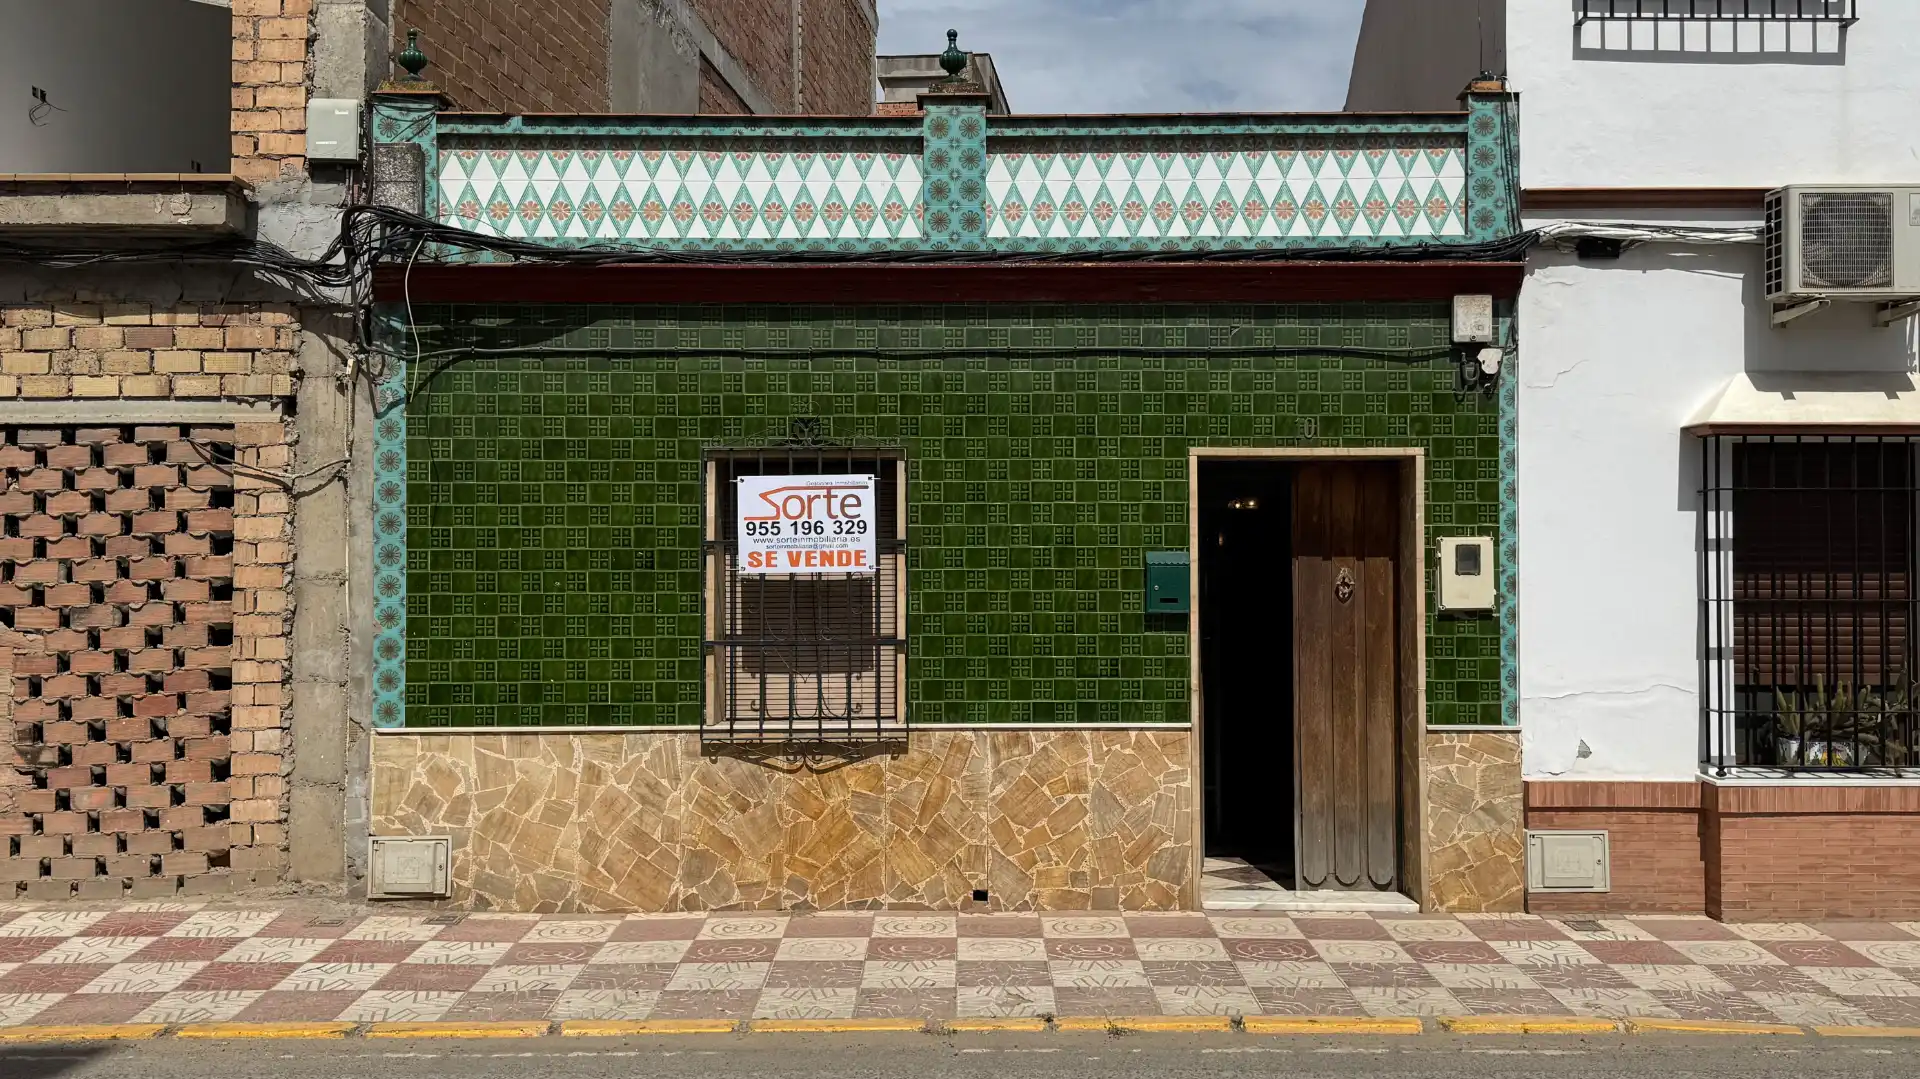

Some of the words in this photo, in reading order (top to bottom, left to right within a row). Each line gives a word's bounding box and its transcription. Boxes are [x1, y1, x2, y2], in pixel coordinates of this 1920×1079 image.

[744, 485, 869, 521] Sorte
[746, 521, 781, 536] 955
[790, 520, 824, 535] 196
[833, 520, 867, 535] 329
[753, 535, 861, 544] www.sorteinmobiliaria.es
[747, 550, 778, 568] SE
[787, 550, 867, 568] VENDE
